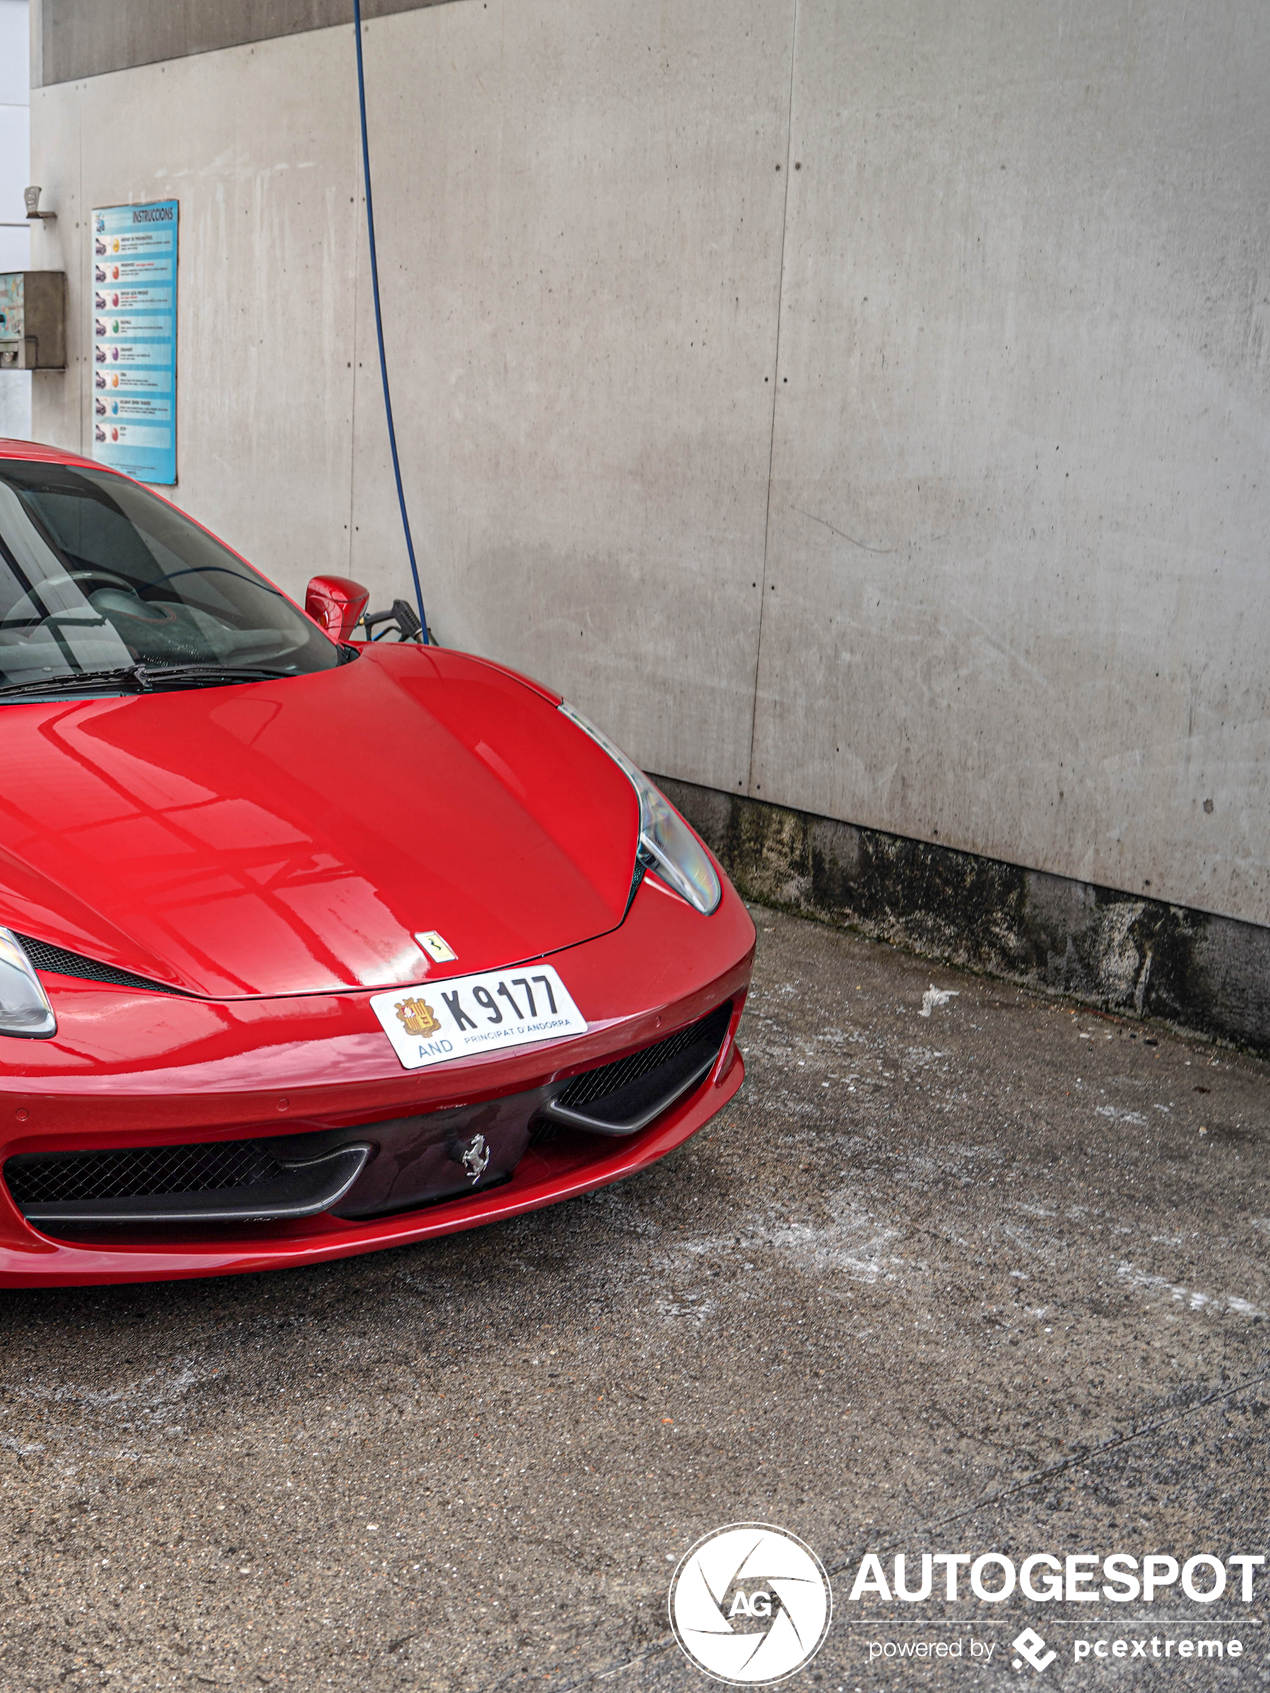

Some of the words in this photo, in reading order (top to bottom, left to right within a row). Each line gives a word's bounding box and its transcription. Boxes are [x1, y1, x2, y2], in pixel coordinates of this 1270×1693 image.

[132, 206, 174, 224] INSTRUCCIONS
[441, 990, 478, 1031] K
[473, 975, 558, 1024] 9177
[464, 1028, 516, 1045] PRINCIPAT
[518, 1018, 572, 1034] D'ANDORRA
[418, 1039, 454, 1058] AND
